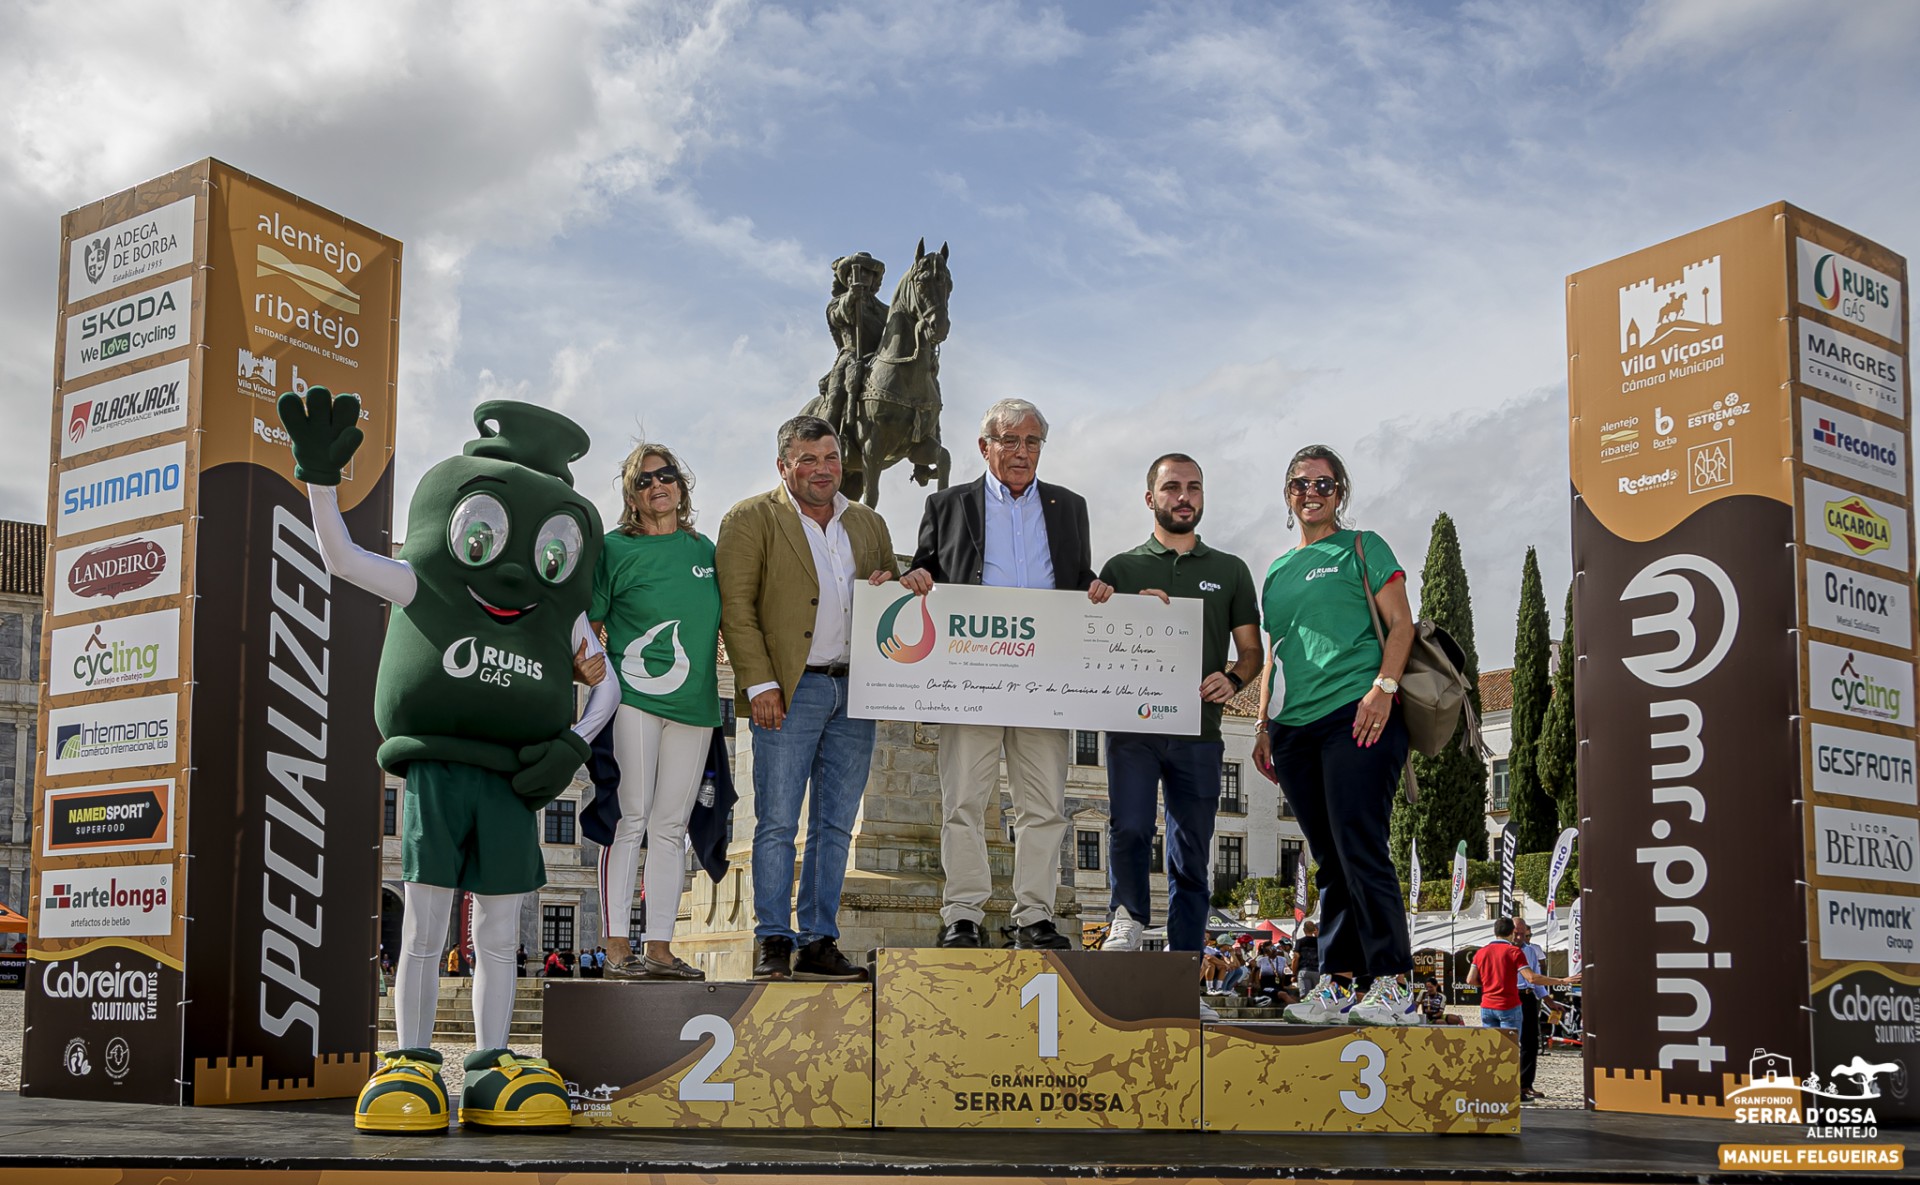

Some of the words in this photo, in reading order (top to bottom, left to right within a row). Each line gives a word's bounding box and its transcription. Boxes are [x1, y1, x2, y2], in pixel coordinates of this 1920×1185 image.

[114, 222, 158, 250] ADEGA
[257, 212, 361, 273] alentejo
[114, 250, 129, 269] DE
[133, 234, 178, 262] BORBA
[112, 264, 145, 283] Established
[147, 259, 163, 271] 1955
[255, 294, 359, 349] ribatejo
[1842, 298, 1865, 323] GÁS
[81, 347, 99, 364] We
[102, 338, 128, 357] Love
[132, 324, 176, 349] Cycling
[254, 325, 288, 343] ENTIDADE
[289, 338, 321, 354] REGIONAL
[322, 349, 330, 358] DE
[331, 352, 358, 369] TURISMO
[1621, 354, 1656, 377] Vila
[1661, 335, 1724, 365] Viçosa
[1808, 334, 1897, 383] MARGRES
[238, 378, 252, 390] Vila
[253, 384, 276, 397] Viçosa
[1622, 373, 1666, 394] Câmara
[1670, 353, 1724, 380] Municipal
[1809, 366, 1862, 391] CERAMIC
[1869, 387, 1897, 404] TILES
[92, 381, 180, 426] BLACKJACK
[1688, 403, 1750, 428] ESTREMOZ
[91, 424, 106, 433] HIGH
[106, 412, 152, 429] PERFORMANCE
[153, 405, 180, 417] WHEELS
[254, 417, 293, 443] Redo
[1601, 416, 1639, 432] alentejo
[1601, 442, 1639, 458] ribatejo
[1653, 437, 1677, 449] Borba
[1837, 432, 1897, 466] reconco
[64, 464, 180, 515] SHIMANO
[1618, 469, 1680, 494] Redondo
[1828, 509, 1888, 542] CAÇAROLA
[74, 551, 159, 585] LANDEIRO
[1825, 572, 1889, 617] Brinox
[1836, 615, 1853, 628] Metal
[1854, 618, 1881, 634] Solutions
[948, 639, 971, 654] POR
[989, 641, 1036, 657] CAUSA
[73, 641, 160, 686] cycling
[480, 667, 512, 687] GÁS
[93, 676, 116, 686] alentejo
[120, 673, 143, 684] ribatejo
[1832, 675, 1900, 720] cycling
[81, 719, 169, 746] Intermanos
[81, 745, 110, 758] comércio
[1818, 745, 1912, 785] GESFROTA
[259, 505, 331, 1058] SPECIALIZED
[68, 802, 145, 823] NAMEDSPORT
[76, 823, 125, 835] SUPERFOOD
[1850, 822, 1887, 834] LICOR
[1825, 829, 1913, 872] BEIRÃO
[72, 878, 167, 913] artelonga
[1636, 699, 1732, 1073] mr.print
[71, 917, 100, 927] artefactos
[102, 917, 110, 926] de
[111, 916, 130, 926] betão
[1829, 900, 1912, 930] Polymark
[1412, 953, 1434, 965] reira
[1886, 936, 1913, 953] Group
[43, 961, 147, 998] Cabreira
[147, 972, 158, 1019] EVENTOS
[1829, 984, 1914, 1021] Cabreira
[92, 1002, 146, 1021] SOLUTIONS
[1020, 972, 1059, 1058] 1
[1875, 1025, 1915, 1043] SOLUTIONS
[679, 1014, 735, 1101] 2
[991, 1075, 1088, 1089] GRANFONDO
[1339, 1040, 1387, 1114] 3
[583, 1103, 612, 1111] D'OSSA
[954, 1092, 1033, 1112] SERRA
[1040, 1092, 1125, 1112] D'OSSA
[1456, 1098, 1509, 1114] Brinox
